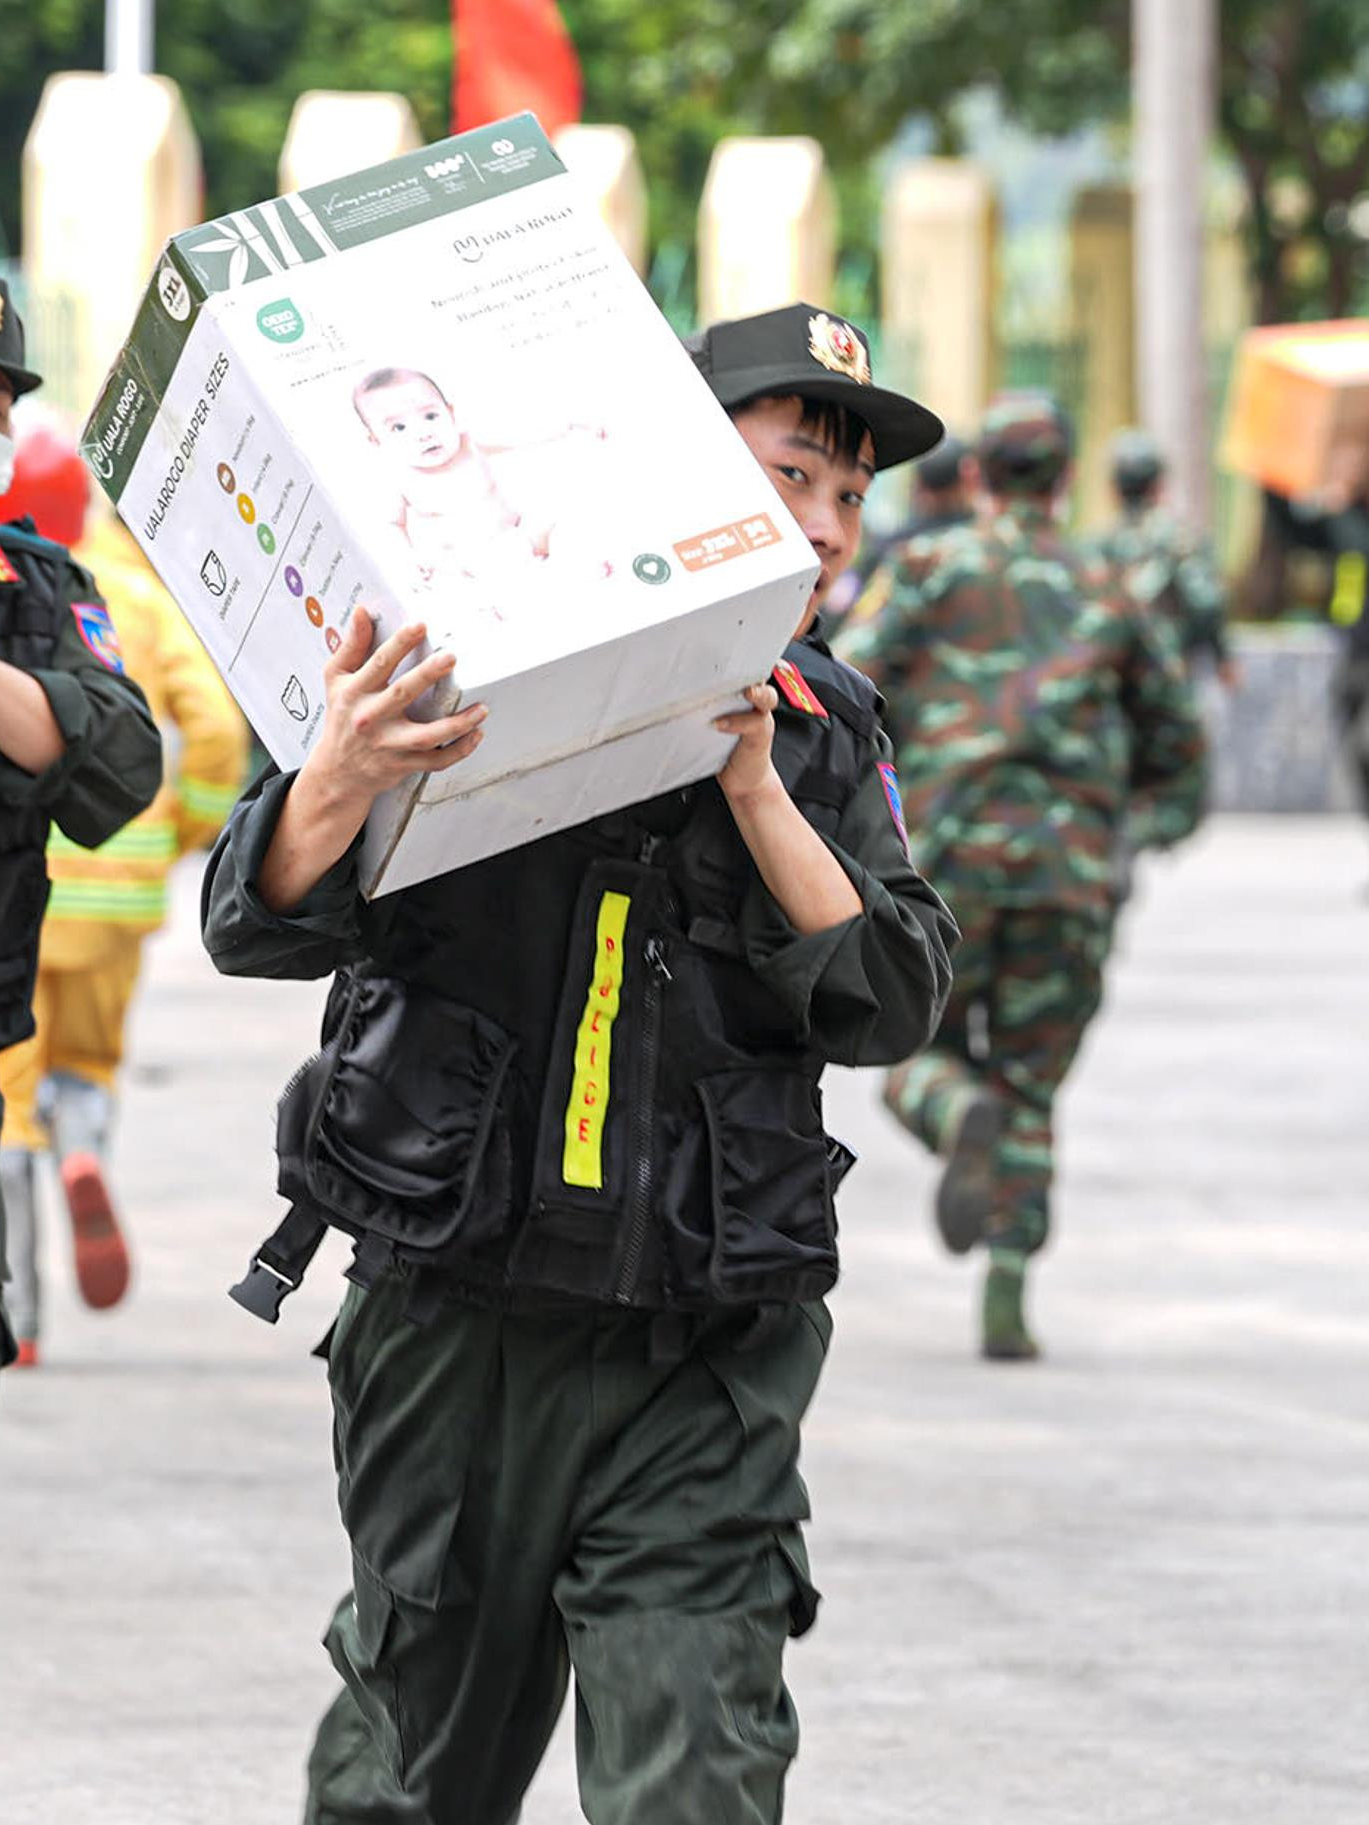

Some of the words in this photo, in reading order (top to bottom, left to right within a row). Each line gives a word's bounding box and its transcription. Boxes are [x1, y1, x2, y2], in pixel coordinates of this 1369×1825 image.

[102, 417, 123, 451] UALA
[116, 378, 138, 419] ROGO
[143, 455, 186, 541] UALAROGO
[180, 398, 211, 461] DIAPER
[204, 351, 231, 401] SIZES
